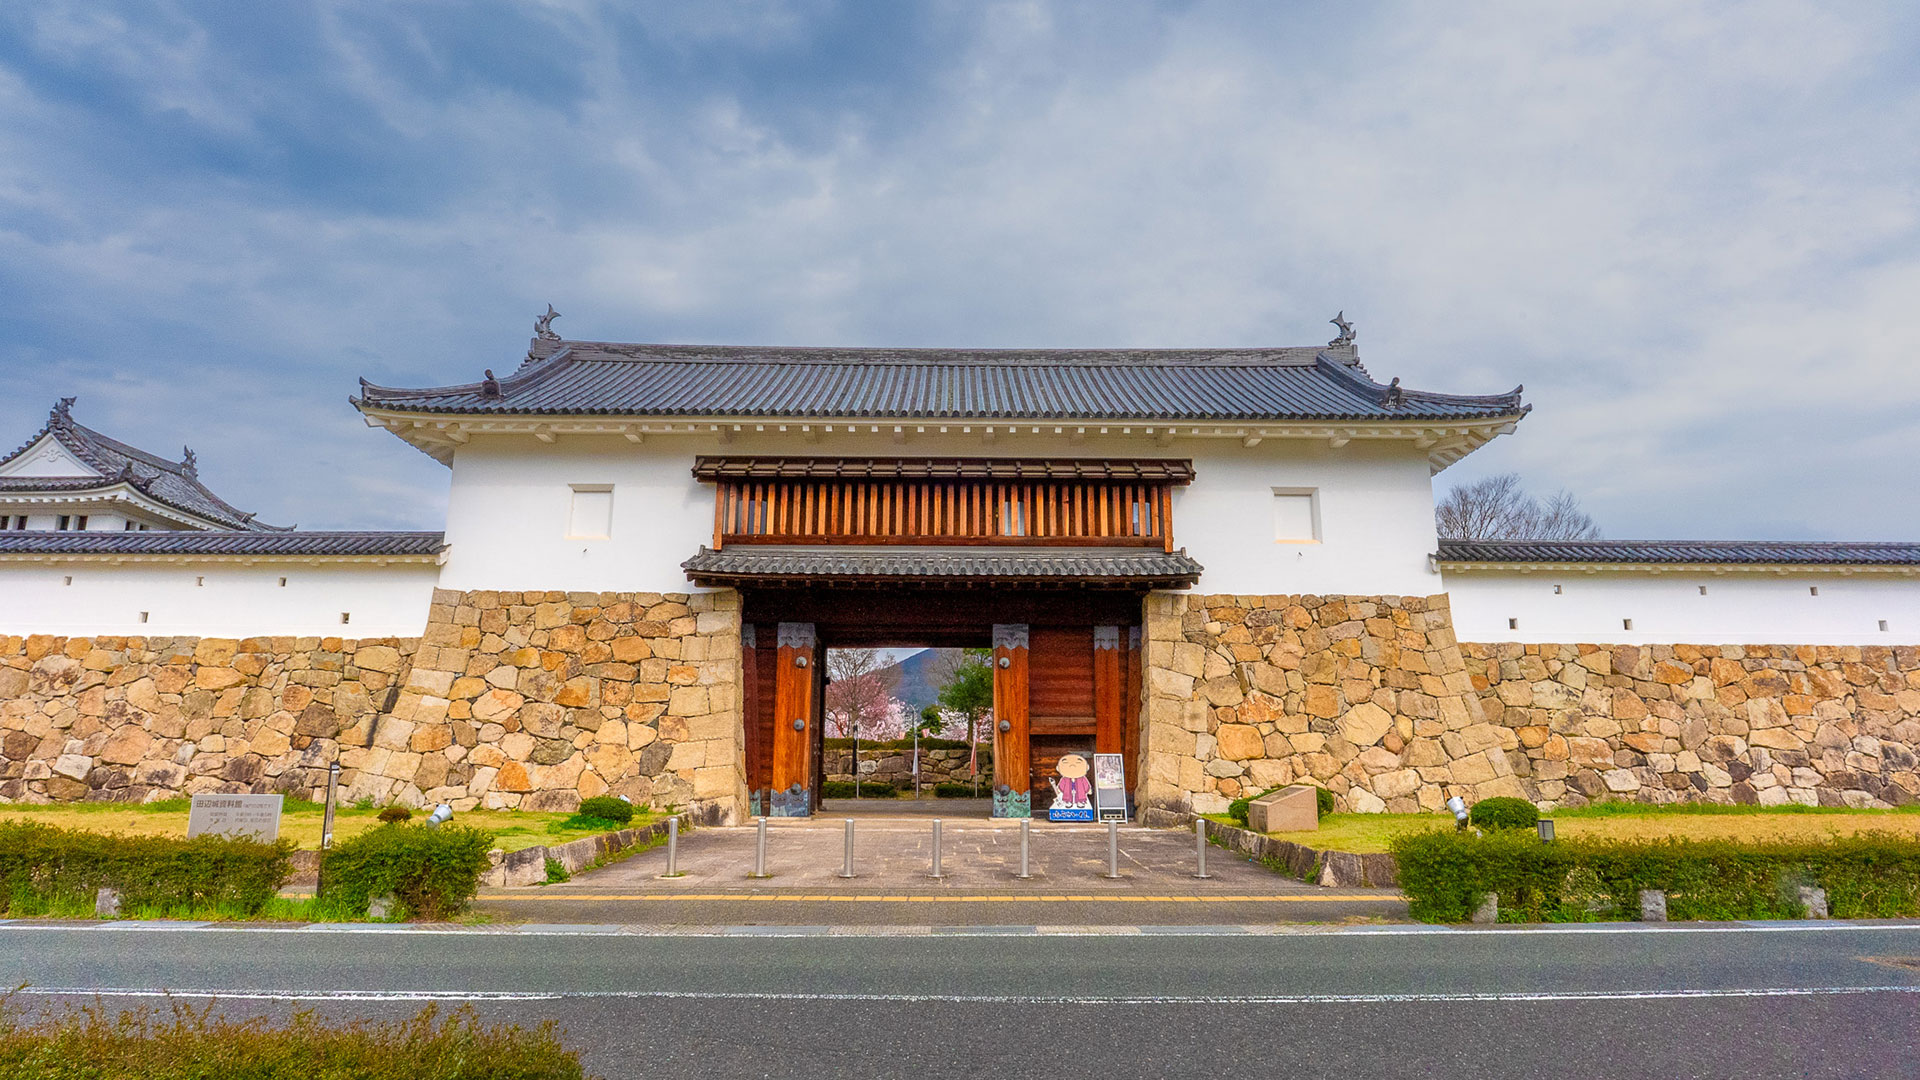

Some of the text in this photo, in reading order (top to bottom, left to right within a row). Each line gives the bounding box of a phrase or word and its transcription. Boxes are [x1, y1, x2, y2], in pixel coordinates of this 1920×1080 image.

[196, 800, 242, 808] 田辺城資料館
